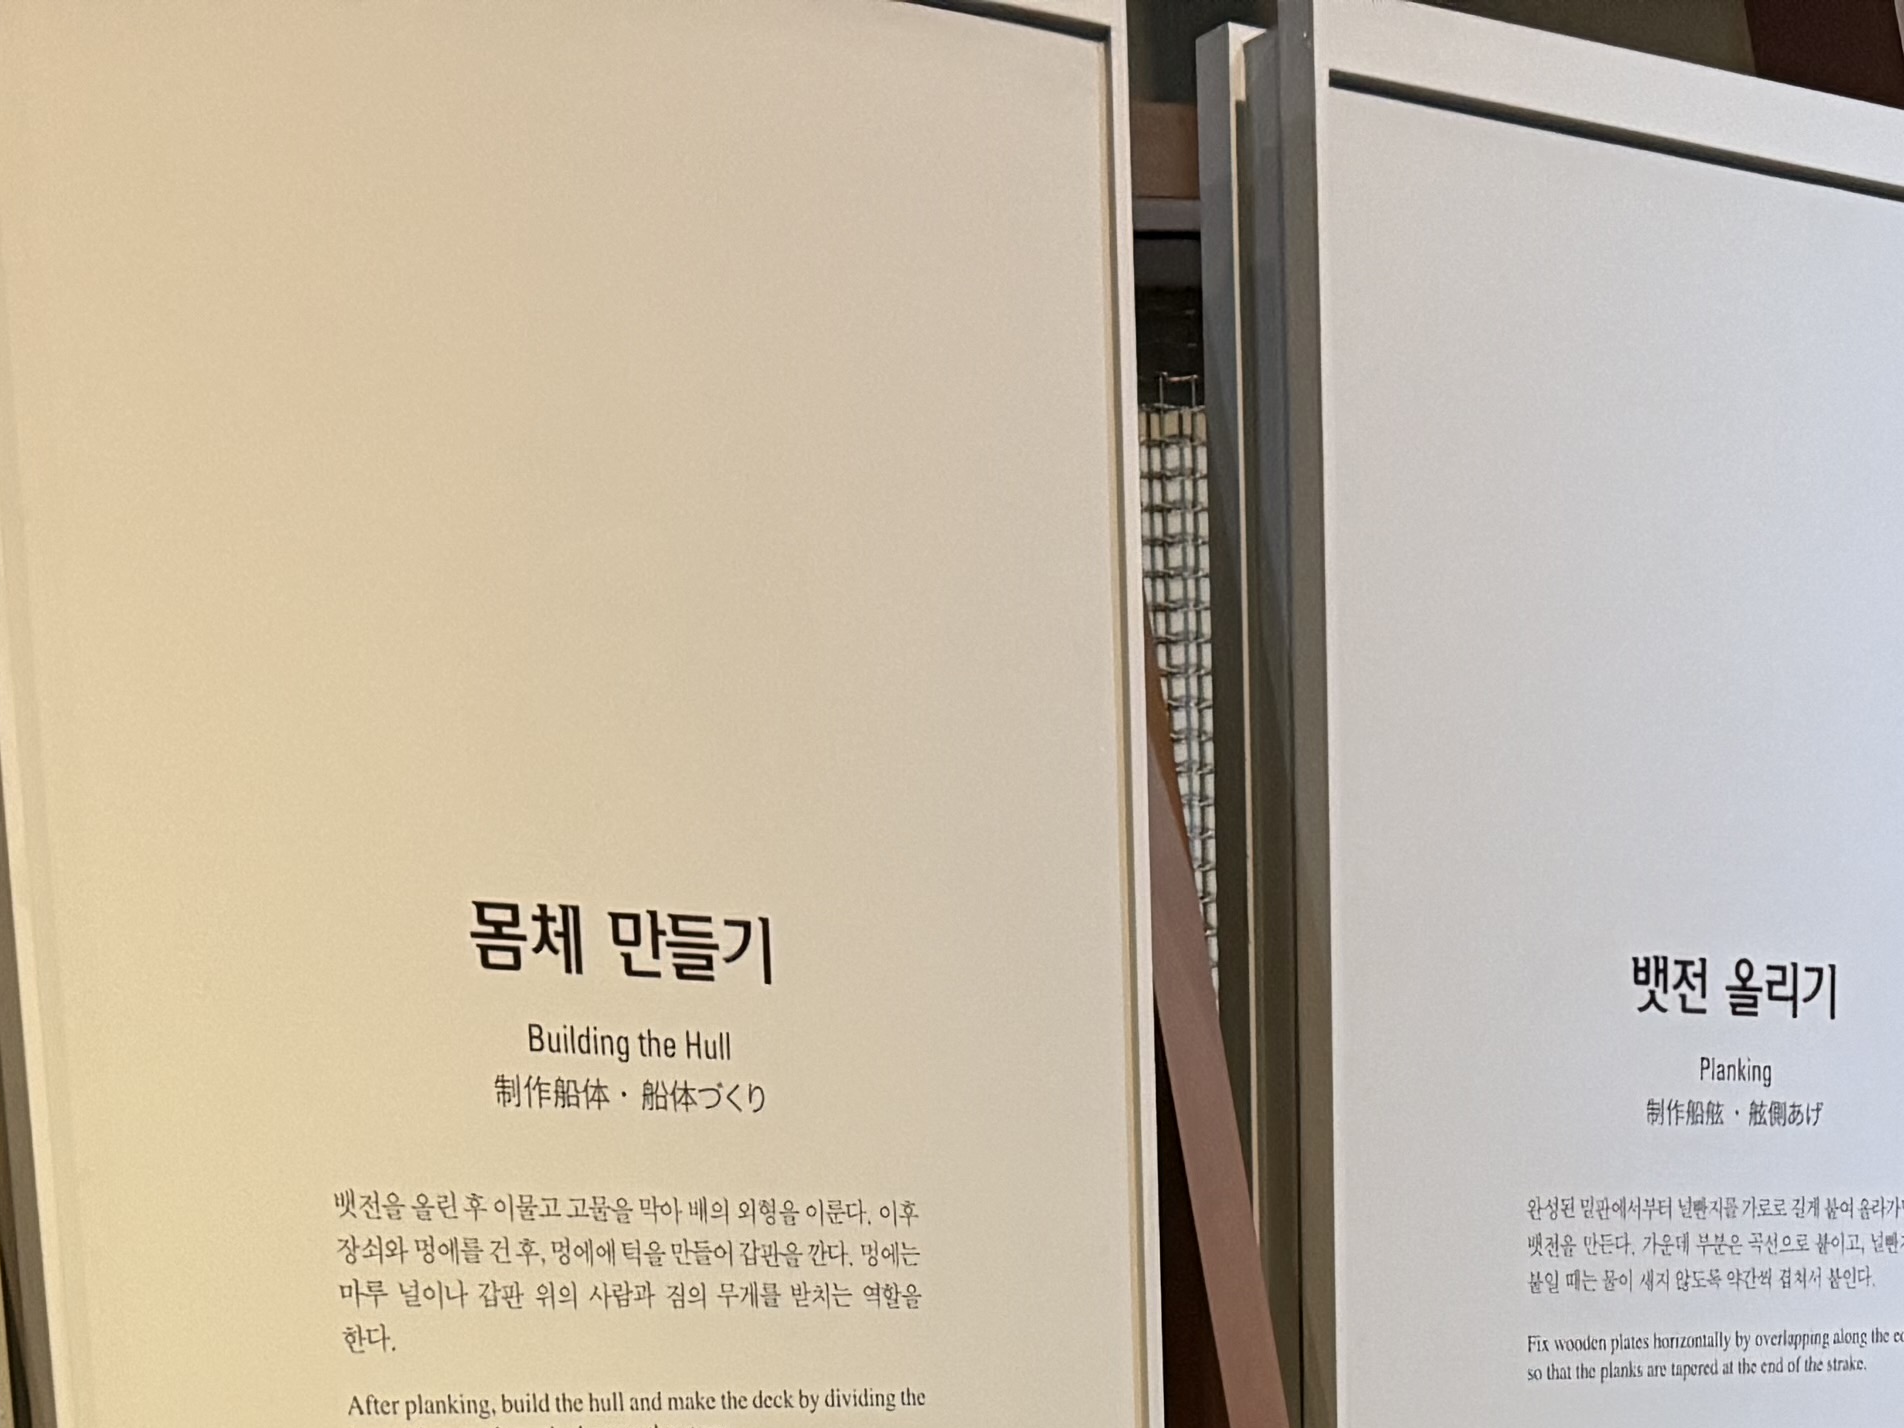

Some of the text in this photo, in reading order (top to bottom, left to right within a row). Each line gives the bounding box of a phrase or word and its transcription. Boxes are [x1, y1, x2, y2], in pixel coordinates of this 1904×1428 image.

[469, 900, 772, 986] 몸체 만들기
[1631, 954, 1837, 1021] 뱃전 올리기
[527, 1023, 731, 1064] Building the Hull
[1699, 1056, 1772, 1089] Planking
[333, 1187, 407, 1221] 뱃전을
[410, 1189, 459, 1222] 올린
[463, 1192, 488, 1223] 후
[565, 1195, 634, 1225] 고물을
[638, 1195, 684, 1226] 막아
[687, 1195, 730, 1227] 배의
[737, 1197, 801, 1227] 외형을
[805, 1197, 872, 1228] 이룬다.
[879, 1199, 920, 1228] 이후
[336, 1234, 410, 1266] 장쇠와
[413, 1234, 485, 1266] 멍에를
[489, 1235, 513, 1265] 건
[550, 1235, 616, 1268] 멍에에
[620, 1238, 667, 1268] 턱을
[739, 1238, 804, 1269] 갑판을
[807, 1239, 854, 1268] 깐다.
[860, 1239, 921, 1269] 멍에는
[338, 1277, 923, 1311] 마루 널이나 갑판 위의 사람과 짐의 무게를 받치는 역할을
[341, 1322, 397, 1355] 한다.
[1527, 1334, 1550, 1354] Fix
[1553, 1334, 1607, 1352] wooden
[1610, 1332, 1650, 1356] plates
[1653, 1330, 1732, 1353] horizontally
[1734, 1329, 1751, 1353] by
[1754, 1329, 1830, 1351] overlapping
[1832, 1327, 1868, 1349] along
[1871, 1326, 1890, 1344] the
[1527, 1354, 1867, 1385] so that the planks are tapered at the end of the strake.
[347, 1386, 926, 1422] After planking, build the hull and make the deck by dividing the
